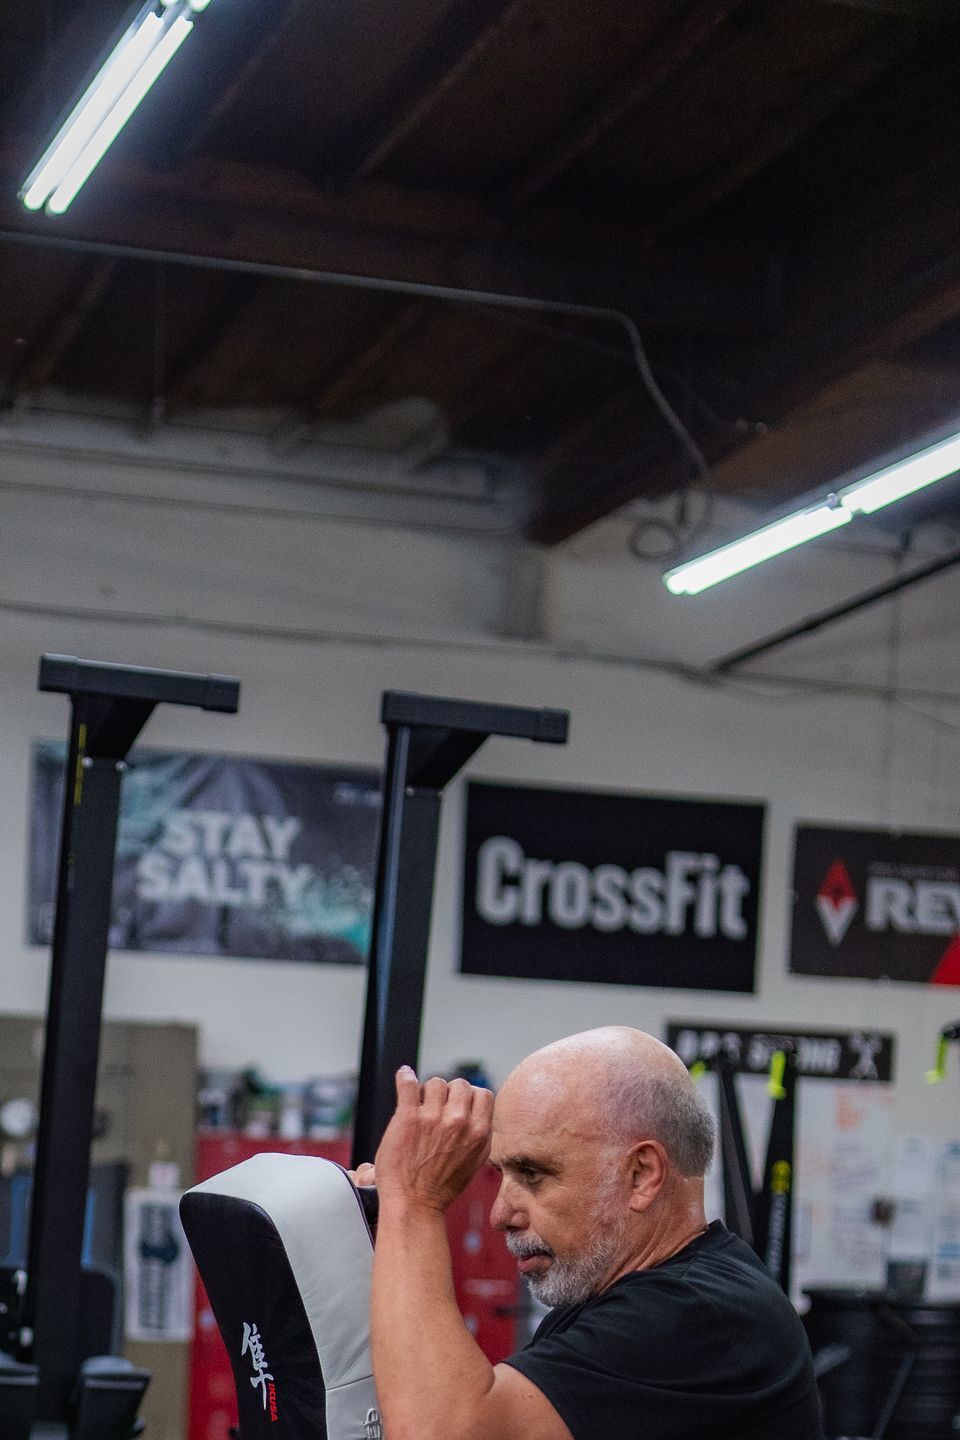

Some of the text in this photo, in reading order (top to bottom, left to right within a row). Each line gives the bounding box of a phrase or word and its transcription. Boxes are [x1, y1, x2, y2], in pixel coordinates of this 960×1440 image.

[161, 810, 302, 859] STAY
[137, 853, 311, 906] SALTY
[474, 835, 751, 940] CrossFit
[268, 1382, 279, 1423] IKUSA
